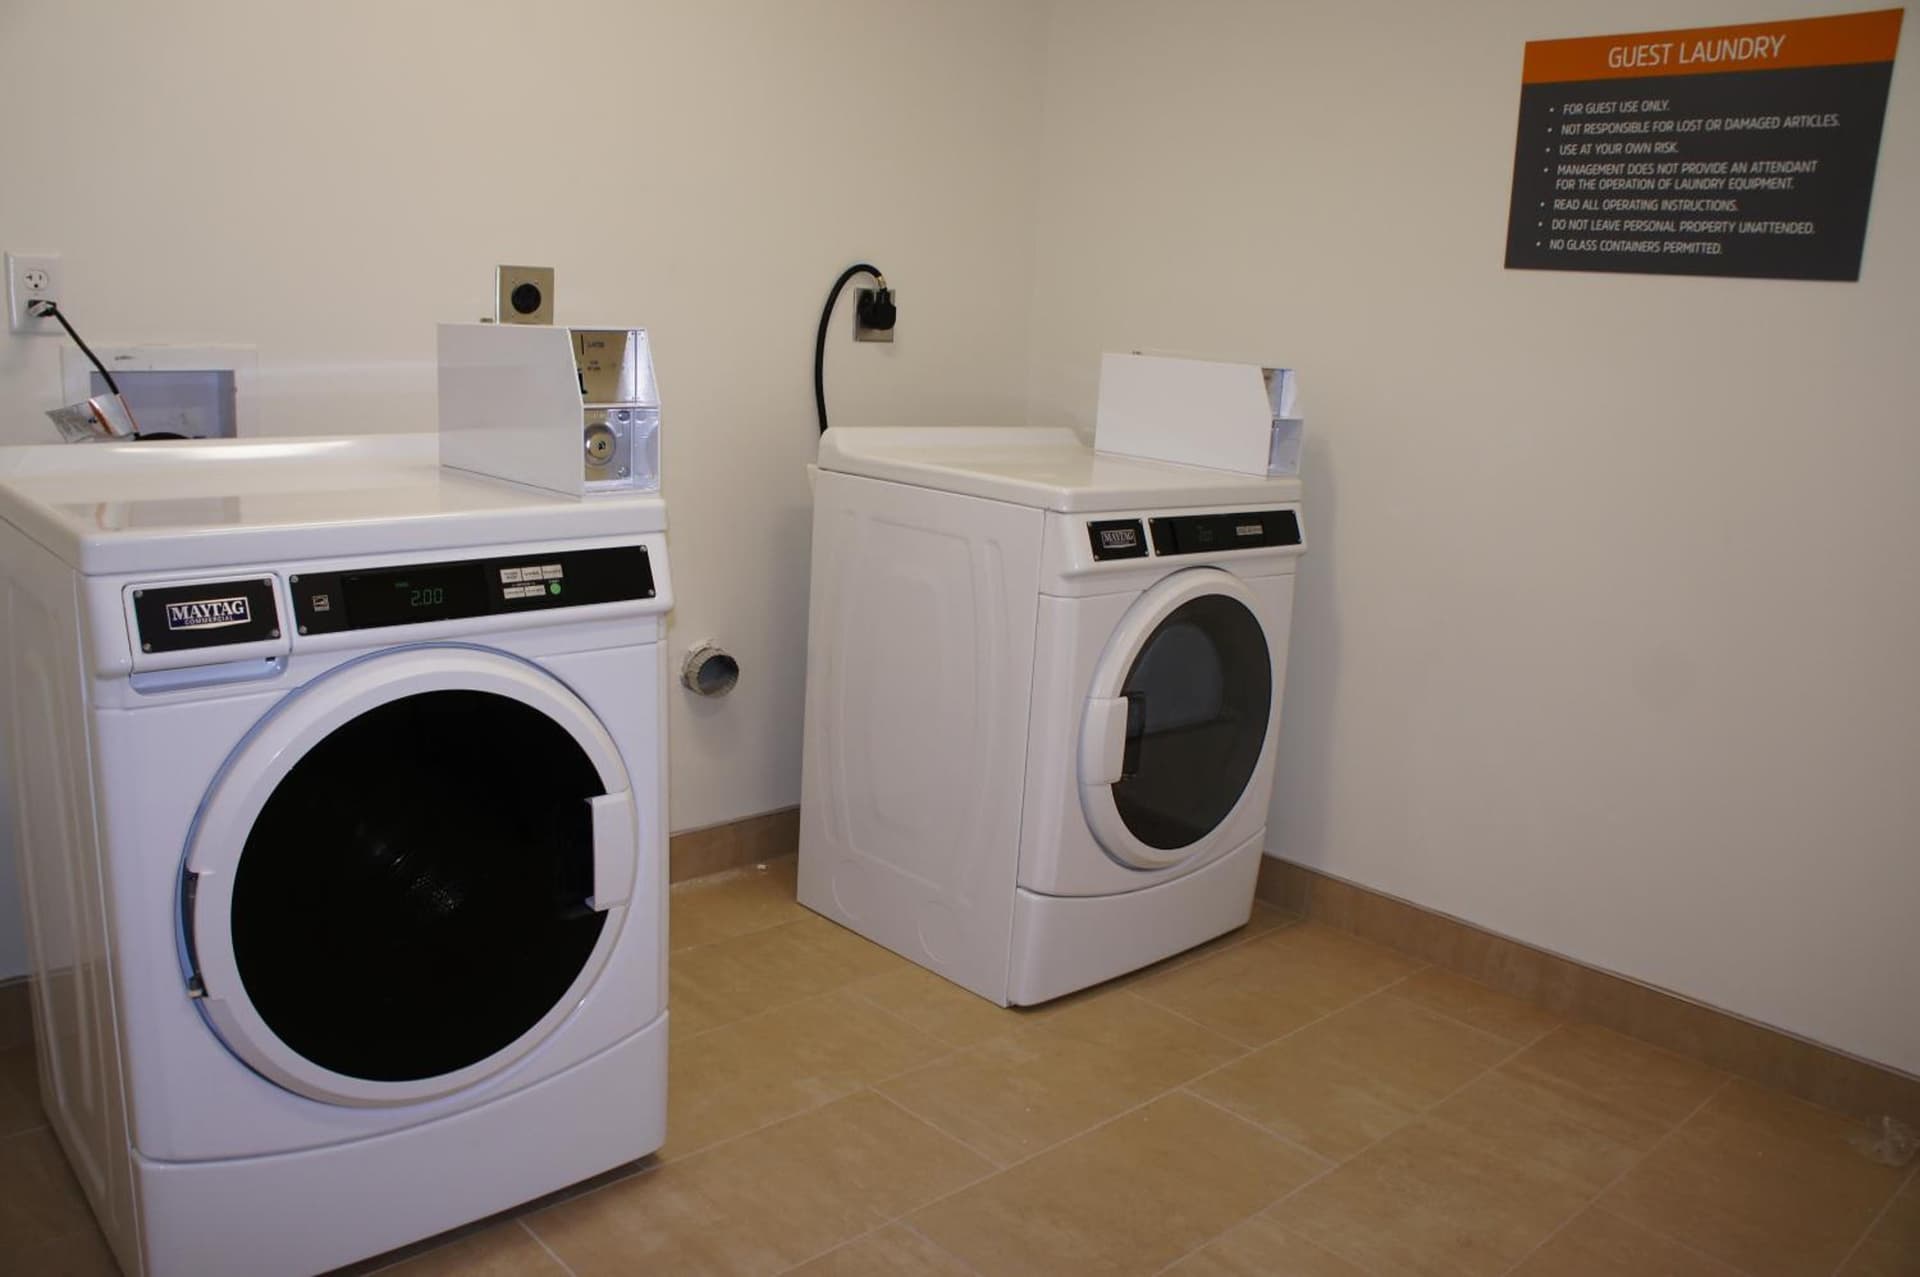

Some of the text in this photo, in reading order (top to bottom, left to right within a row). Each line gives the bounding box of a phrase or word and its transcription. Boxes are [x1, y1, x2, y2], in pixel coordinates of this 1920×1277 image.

[1608, 34, 1786, 68] GUEST LAUNDRY
[1563, 99, 1670, 114] FOR GUEST USE ONLY.
[1561, 114, 1840, 135] NOT RESPONSIBLE FOR LOST OR DAMAGED ARTICLES.
[1560, 142, 1679, 155] USE AT YOUR OWN RISK.
[1557, 160, 1818, 175] MANAGEMENT DOES NOT PROVIDE AN ATTENDANT
[1555, 177, 1794, 190] FOR THE OPERATION OF LAUNDRY EQUIPMENT.
[1554, 200, 1580, 210] READ
[1582, 200, 1600, 210] ALL
[1602, 200, 1659, 210] OPERATING
[1552, 220, 1816, 234] DO NOT LEAVE PERSONAL PROPERTY UNATTENDED.
[1550, 240, 1722, 254] NO GLASS CONTAINERS PERMITTED.
[411, 588, 443, 607] 2.00
[171, 600, 244, 621] MAYTAG
